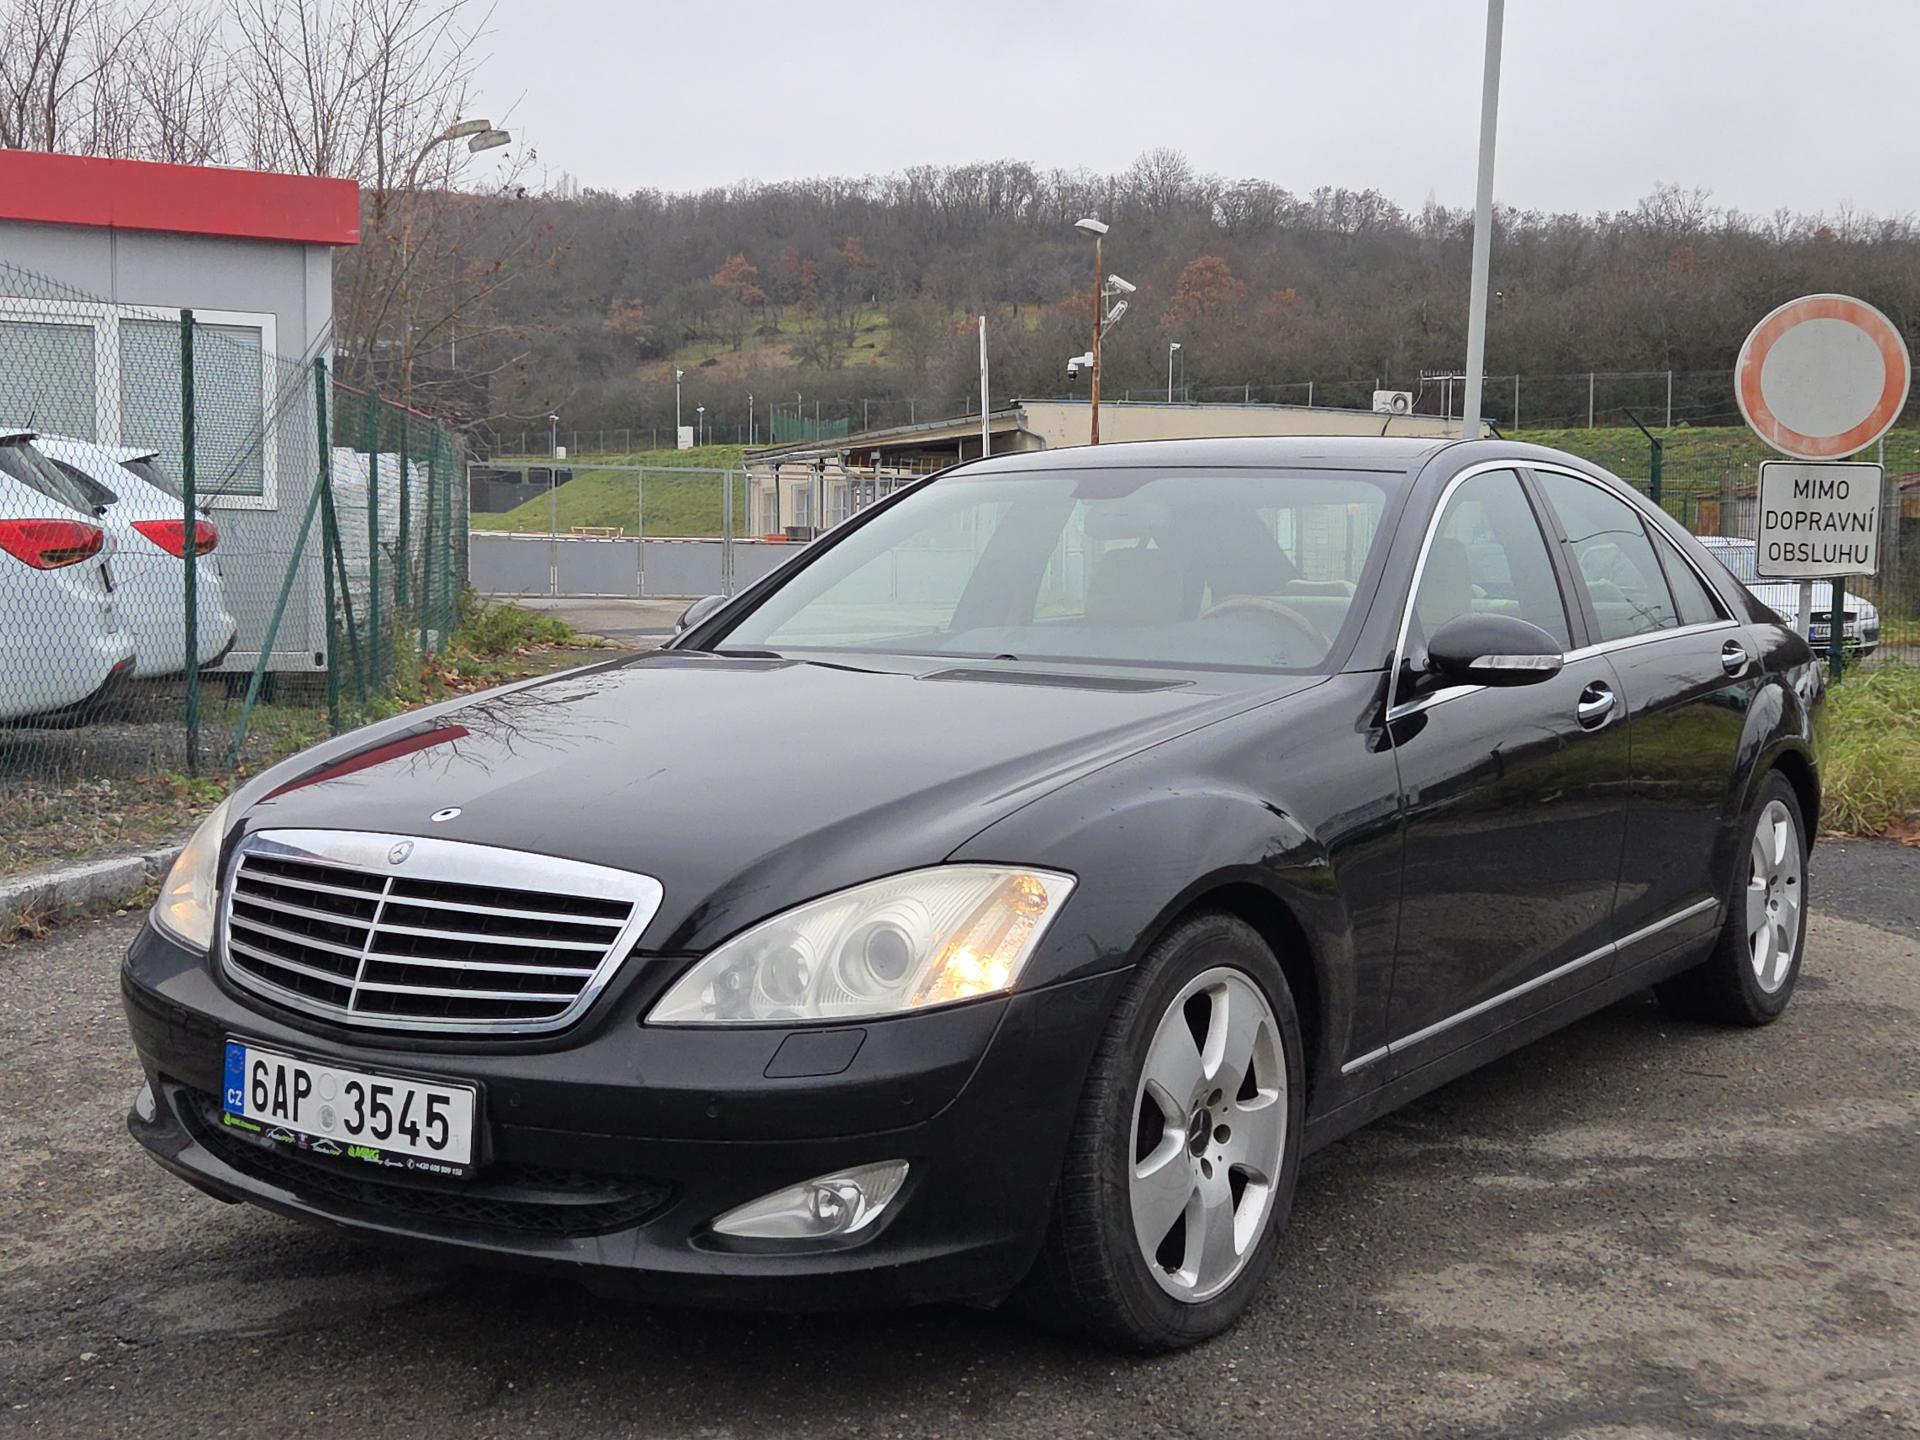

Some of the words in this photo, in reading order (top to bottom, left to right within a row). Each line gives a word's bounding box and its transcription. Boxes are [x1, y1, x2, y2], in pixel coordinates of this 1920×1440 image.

[1793, 479, 1850, 500] MIMO
[1765, 506, 1875, 532] DOPRAVNÍ
[1768, 542, 1869, 564] OBSLUHU
[227, 1088, 243, 1107] CZ
[251, 1060, 312, 1123] 6AP
[343, 1080, 451, 1151] 3545
